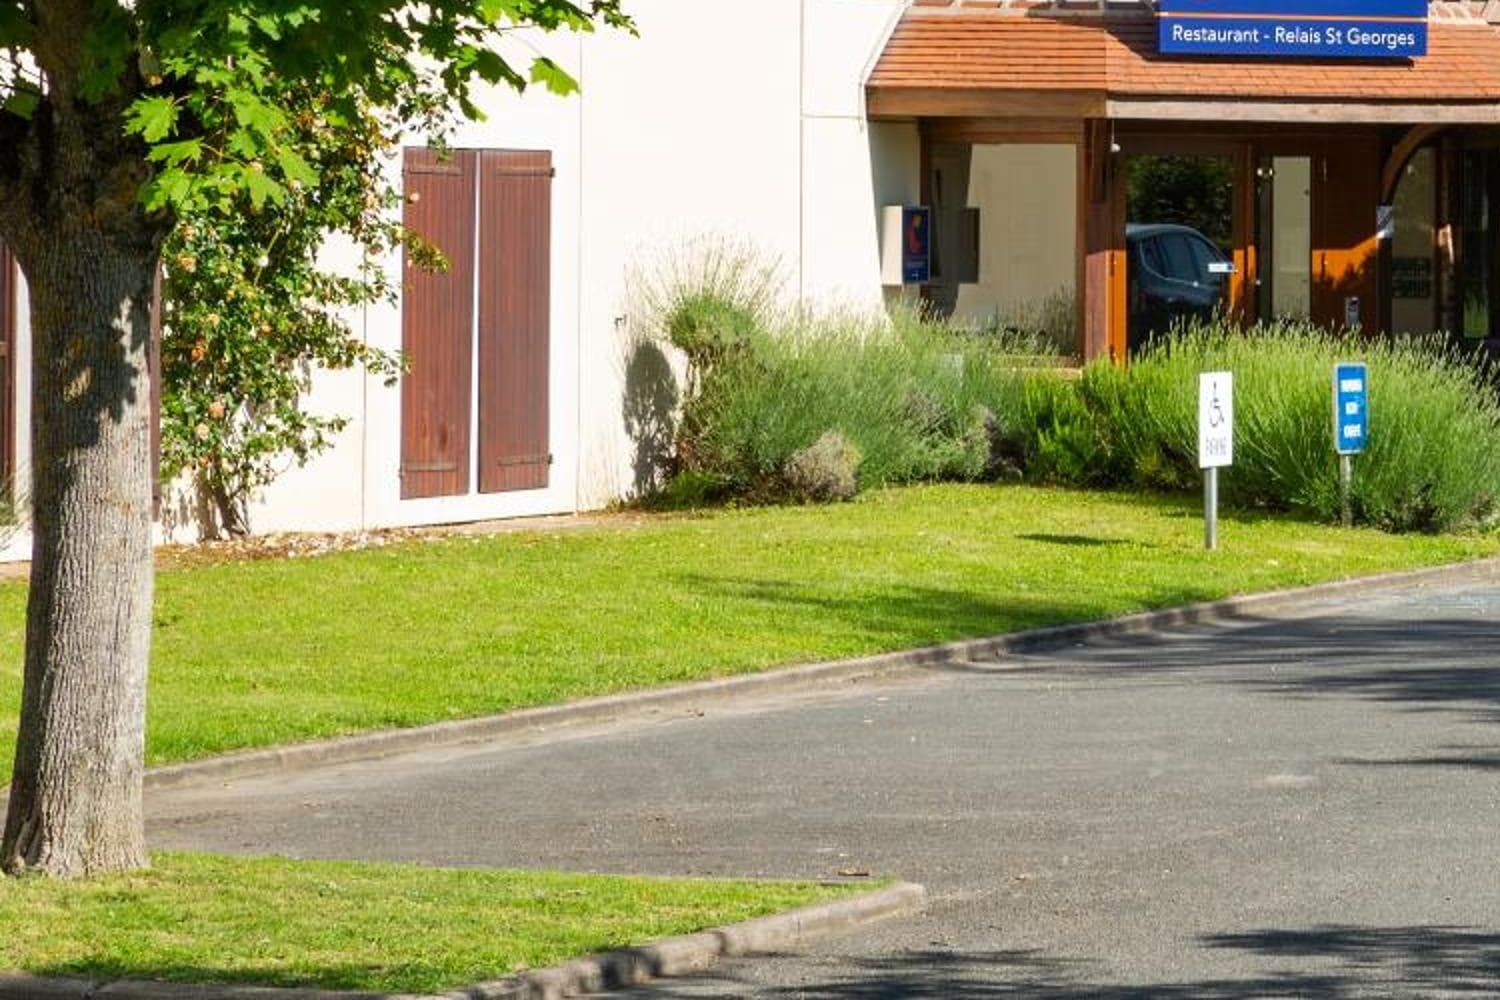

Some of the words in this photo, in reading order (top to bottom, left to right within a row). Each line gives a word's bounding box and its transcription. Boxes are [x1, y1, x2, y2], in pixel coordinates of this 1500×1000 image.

[1172, 24, 1259, 43] Restaurant
[1275, 26, 1321, 44] Relais
[1325, 27, 1342, 44] St
[1347, 27, 1415, 50] Georges
